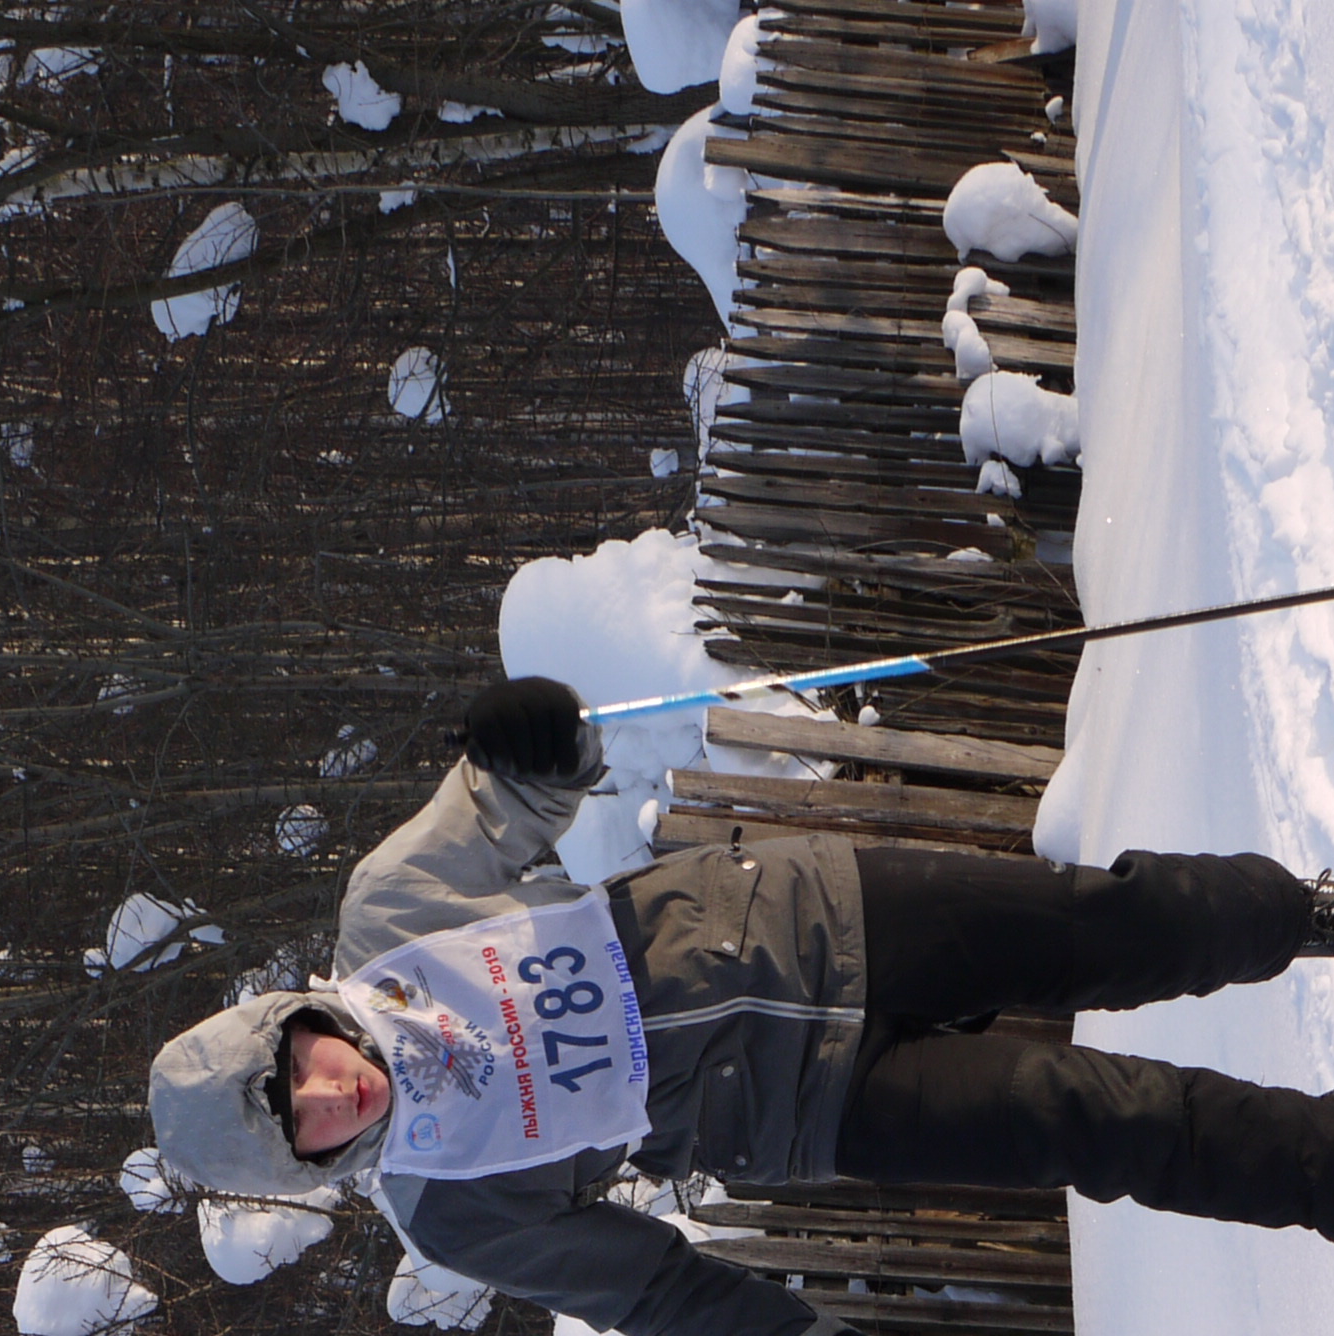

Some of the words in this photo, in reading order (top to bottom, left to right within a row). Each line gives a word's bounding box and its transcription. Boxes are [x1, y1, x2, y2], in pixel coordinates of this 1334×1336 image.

[481, 946, 507, 985] 2019
[604, 940, 633, 985] край
[437, 1013, 457, 1045] 2019
[464, 1020, 496, 1087] РОССИИ
[499, 997, 530, 1071] РОССИИ
[518, 946, 613, 1094] 1783
[620, 990, 648, 1085] Пермский
[392, 1034, 426, 1104] ЛЫЖНЯ
[517, 1072, 540, 1139] ЛЫЖНЯ
